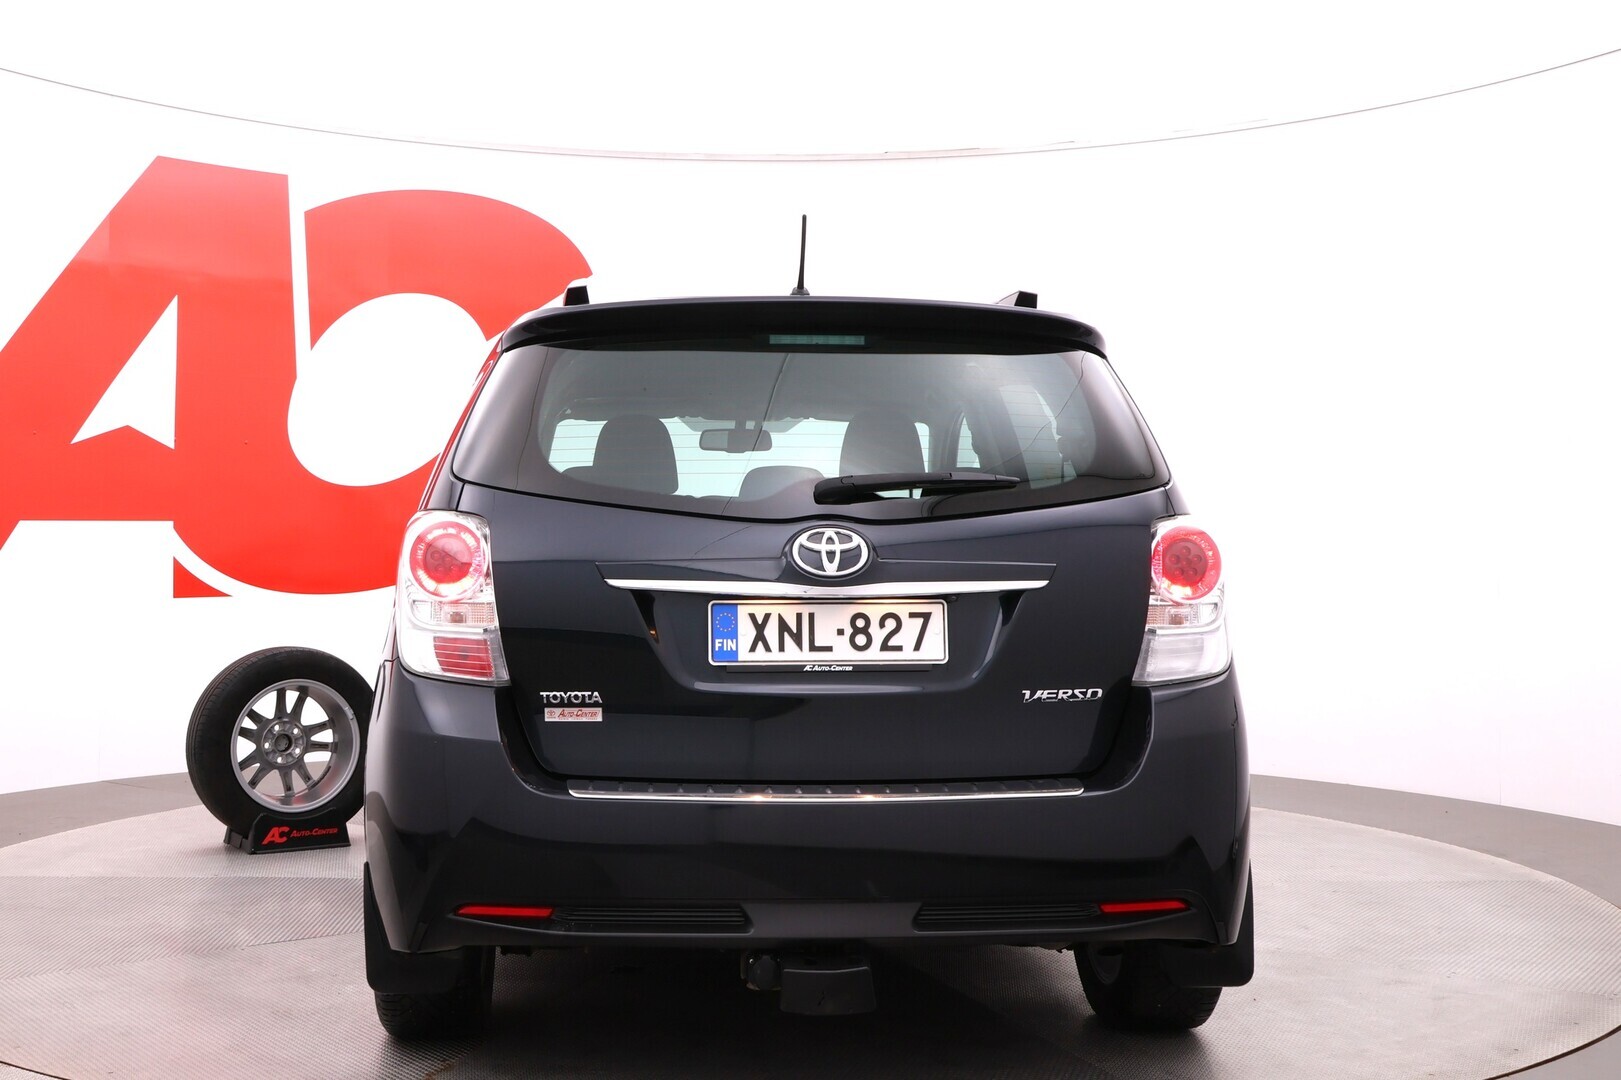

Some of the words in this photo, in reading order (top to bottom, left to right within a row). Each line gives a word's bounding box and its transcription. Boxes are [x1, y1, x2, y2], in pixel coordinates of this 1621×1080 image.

[0, 155, 593, 598] AC
[747, 611, 933, 653] XNL-827
[715, 638, 737, 651] FIN
[539, 691, 603, 704] TOYOTA
[1021, 688, 1103, 703] VERSO
[261, 826, 290, 845] AC
